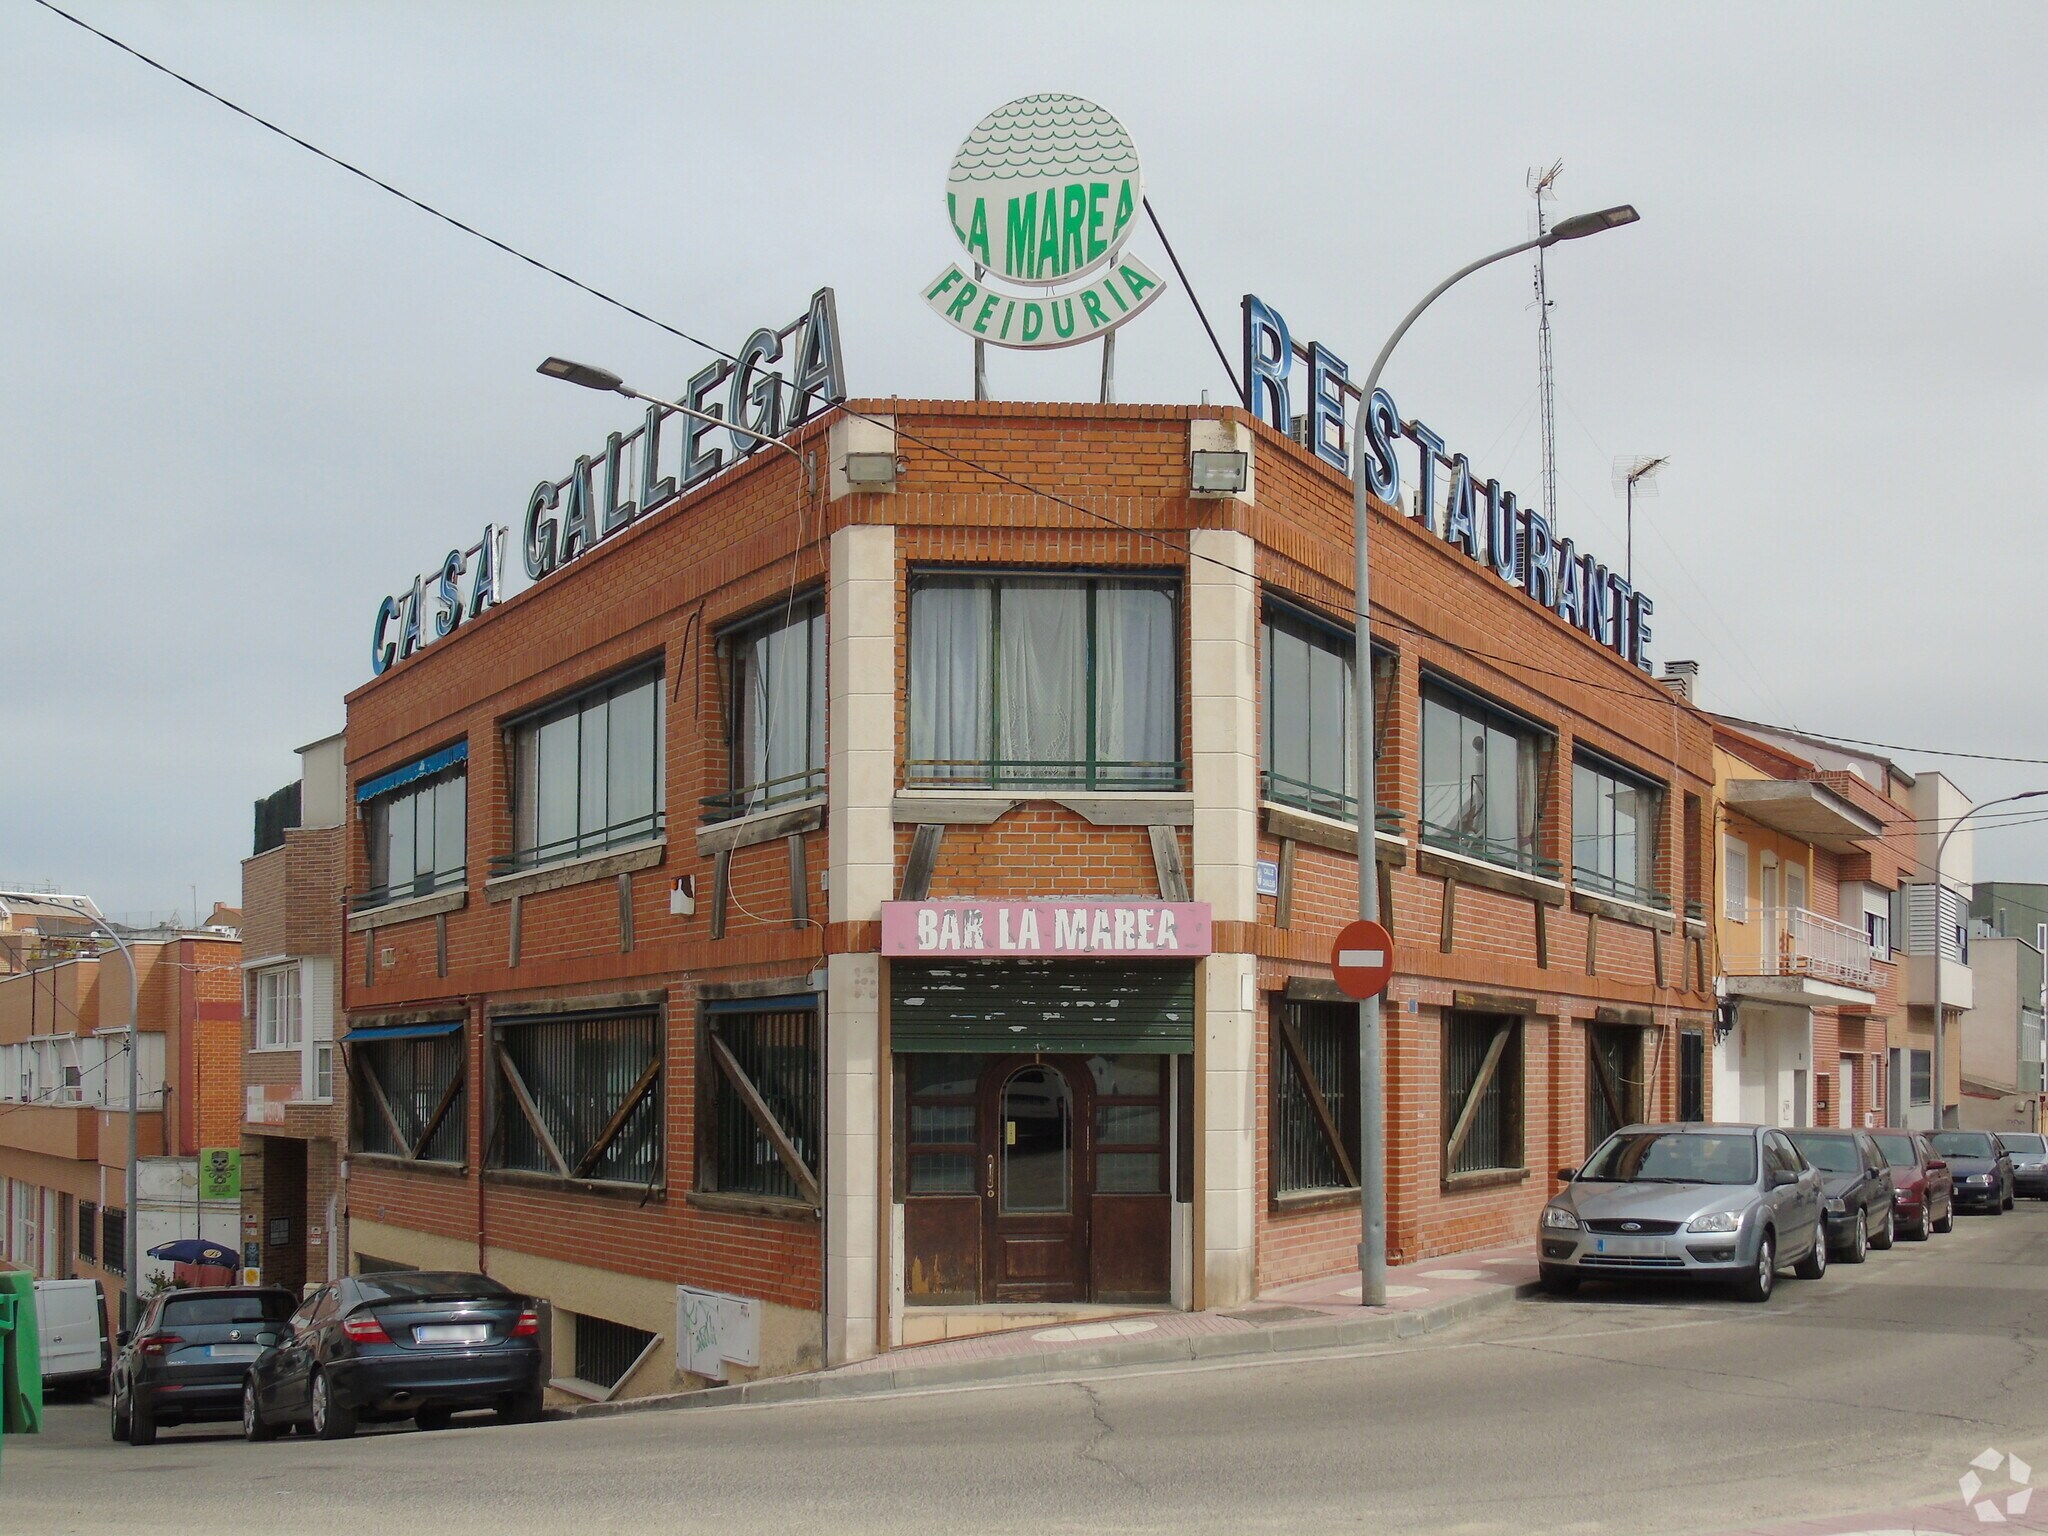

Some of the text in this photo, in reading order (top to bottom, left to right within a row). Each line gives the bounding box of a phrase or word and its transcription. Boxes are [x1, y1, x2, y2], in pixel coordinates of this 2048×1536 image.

[947, 178, 1134, 280] LA MAREA
[926, 264, 1156, 342] FREIDURIA
[372, 286, 847, 676] CASA GALLEGA
[1242, 293, 1654, 675] RESTAURANTE
[917, 908, 1179, 951] BAR LA MAREA
